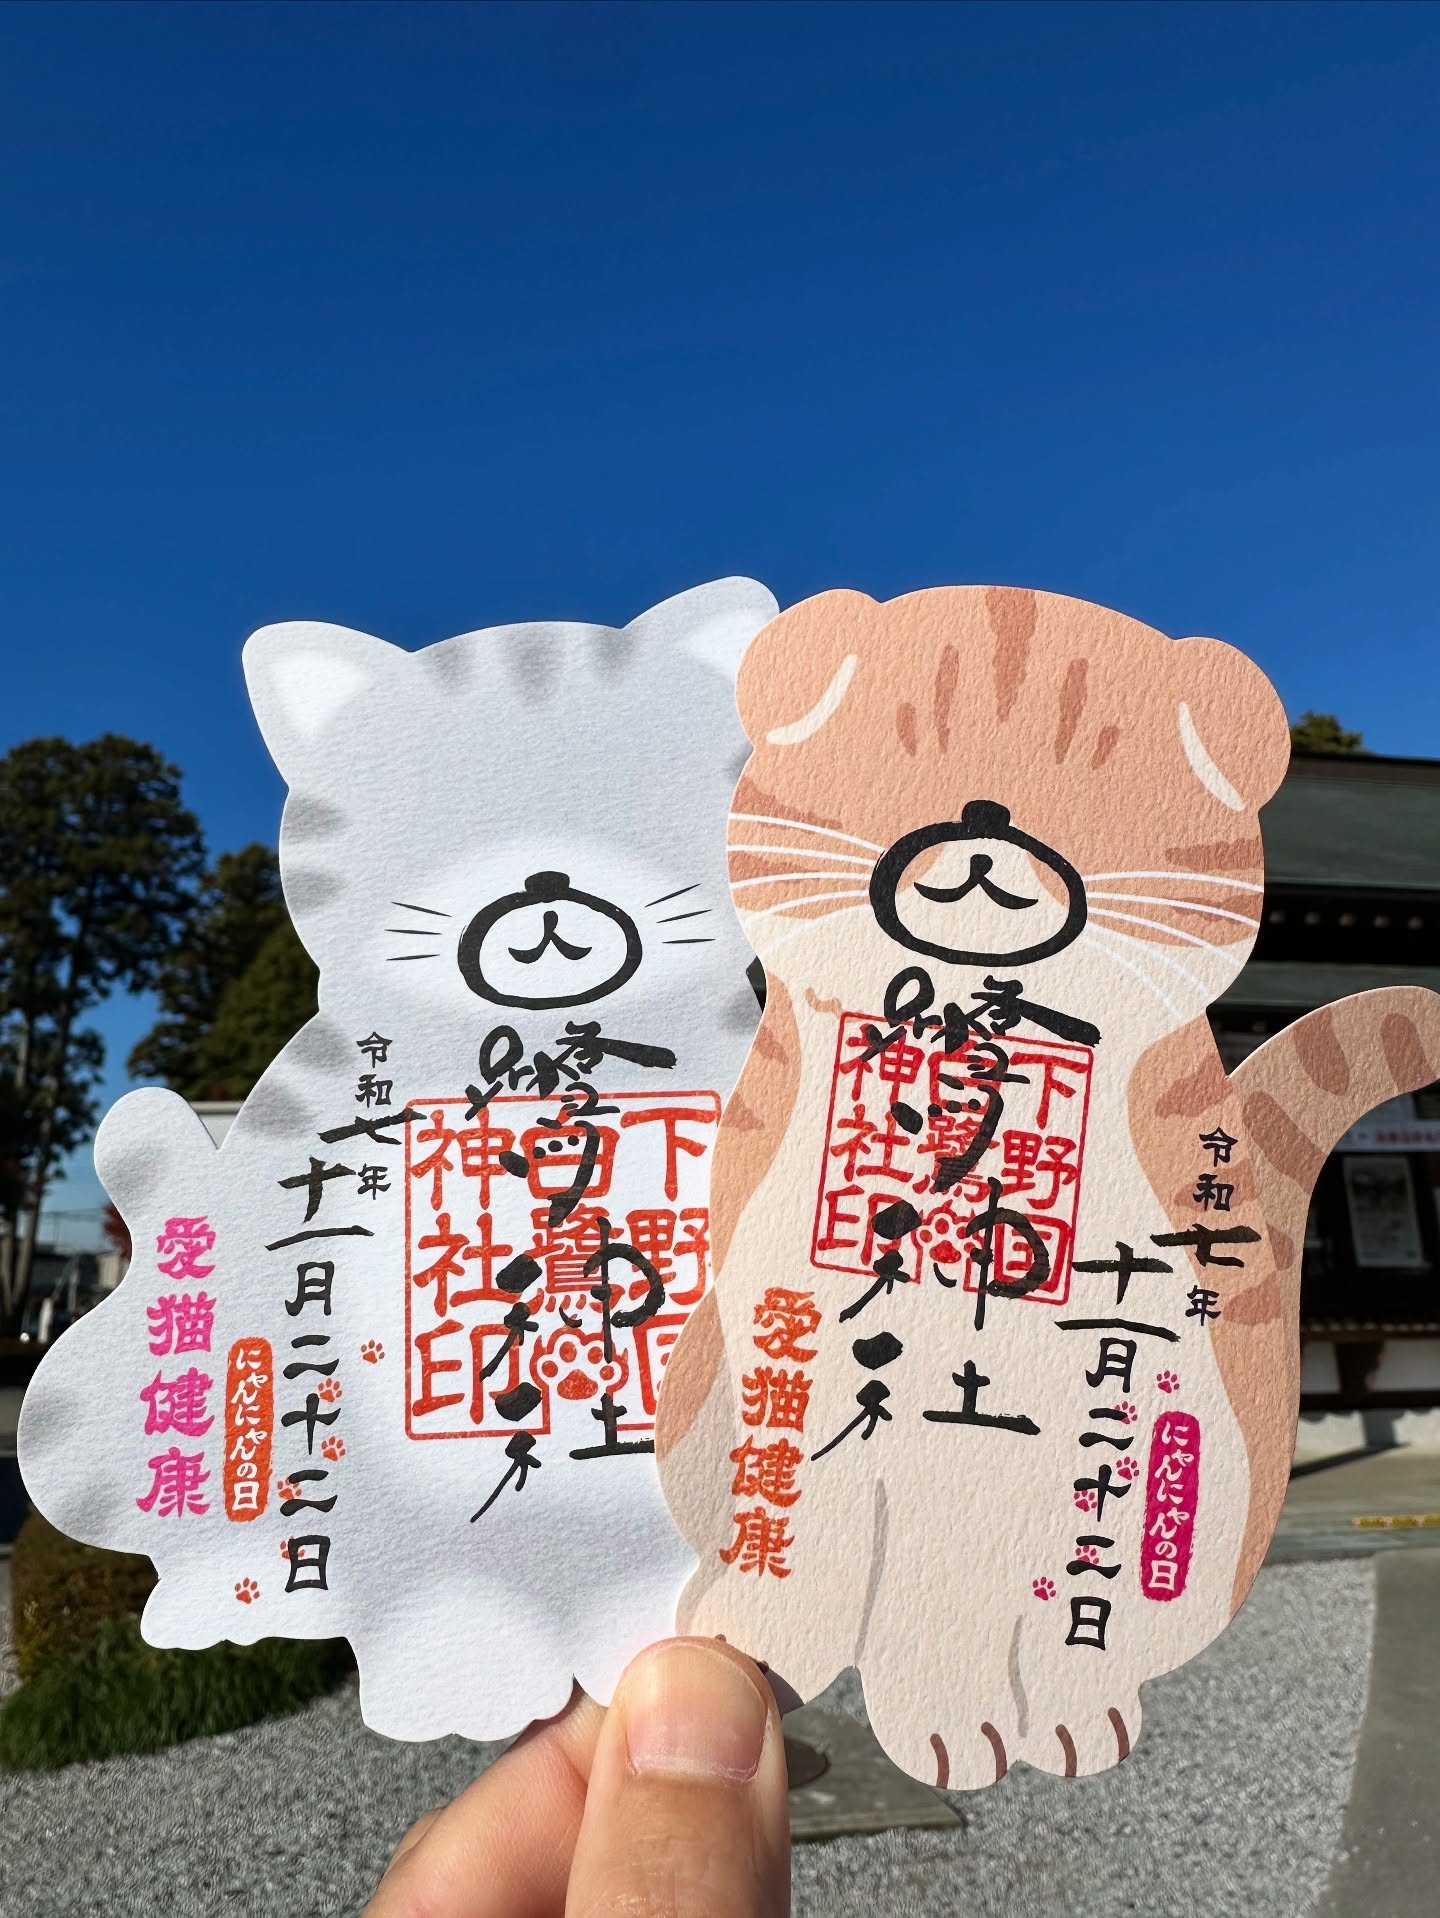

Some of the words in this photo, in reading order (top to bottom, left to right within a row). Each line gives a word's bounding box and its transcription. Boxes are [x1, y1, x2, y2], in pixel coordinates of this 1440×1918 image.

[317, 1031, 427, 1200] 令和七年
[1150, 1127, 1262, 1326] 令和七年
[136, 1215, 217, 1519] 愛猫健康
[229, 1347, 269, 1511] にゃんにゃんの日
[265, 1157, 374, 1592] 十一月二十二日
[719, 1287, 822, 1578] 愛猫健康
[1054, 1241, 1181, 1651] 十一月二十二日
[1148, 1420, 1194, 1592] にゃんにゃんの日
